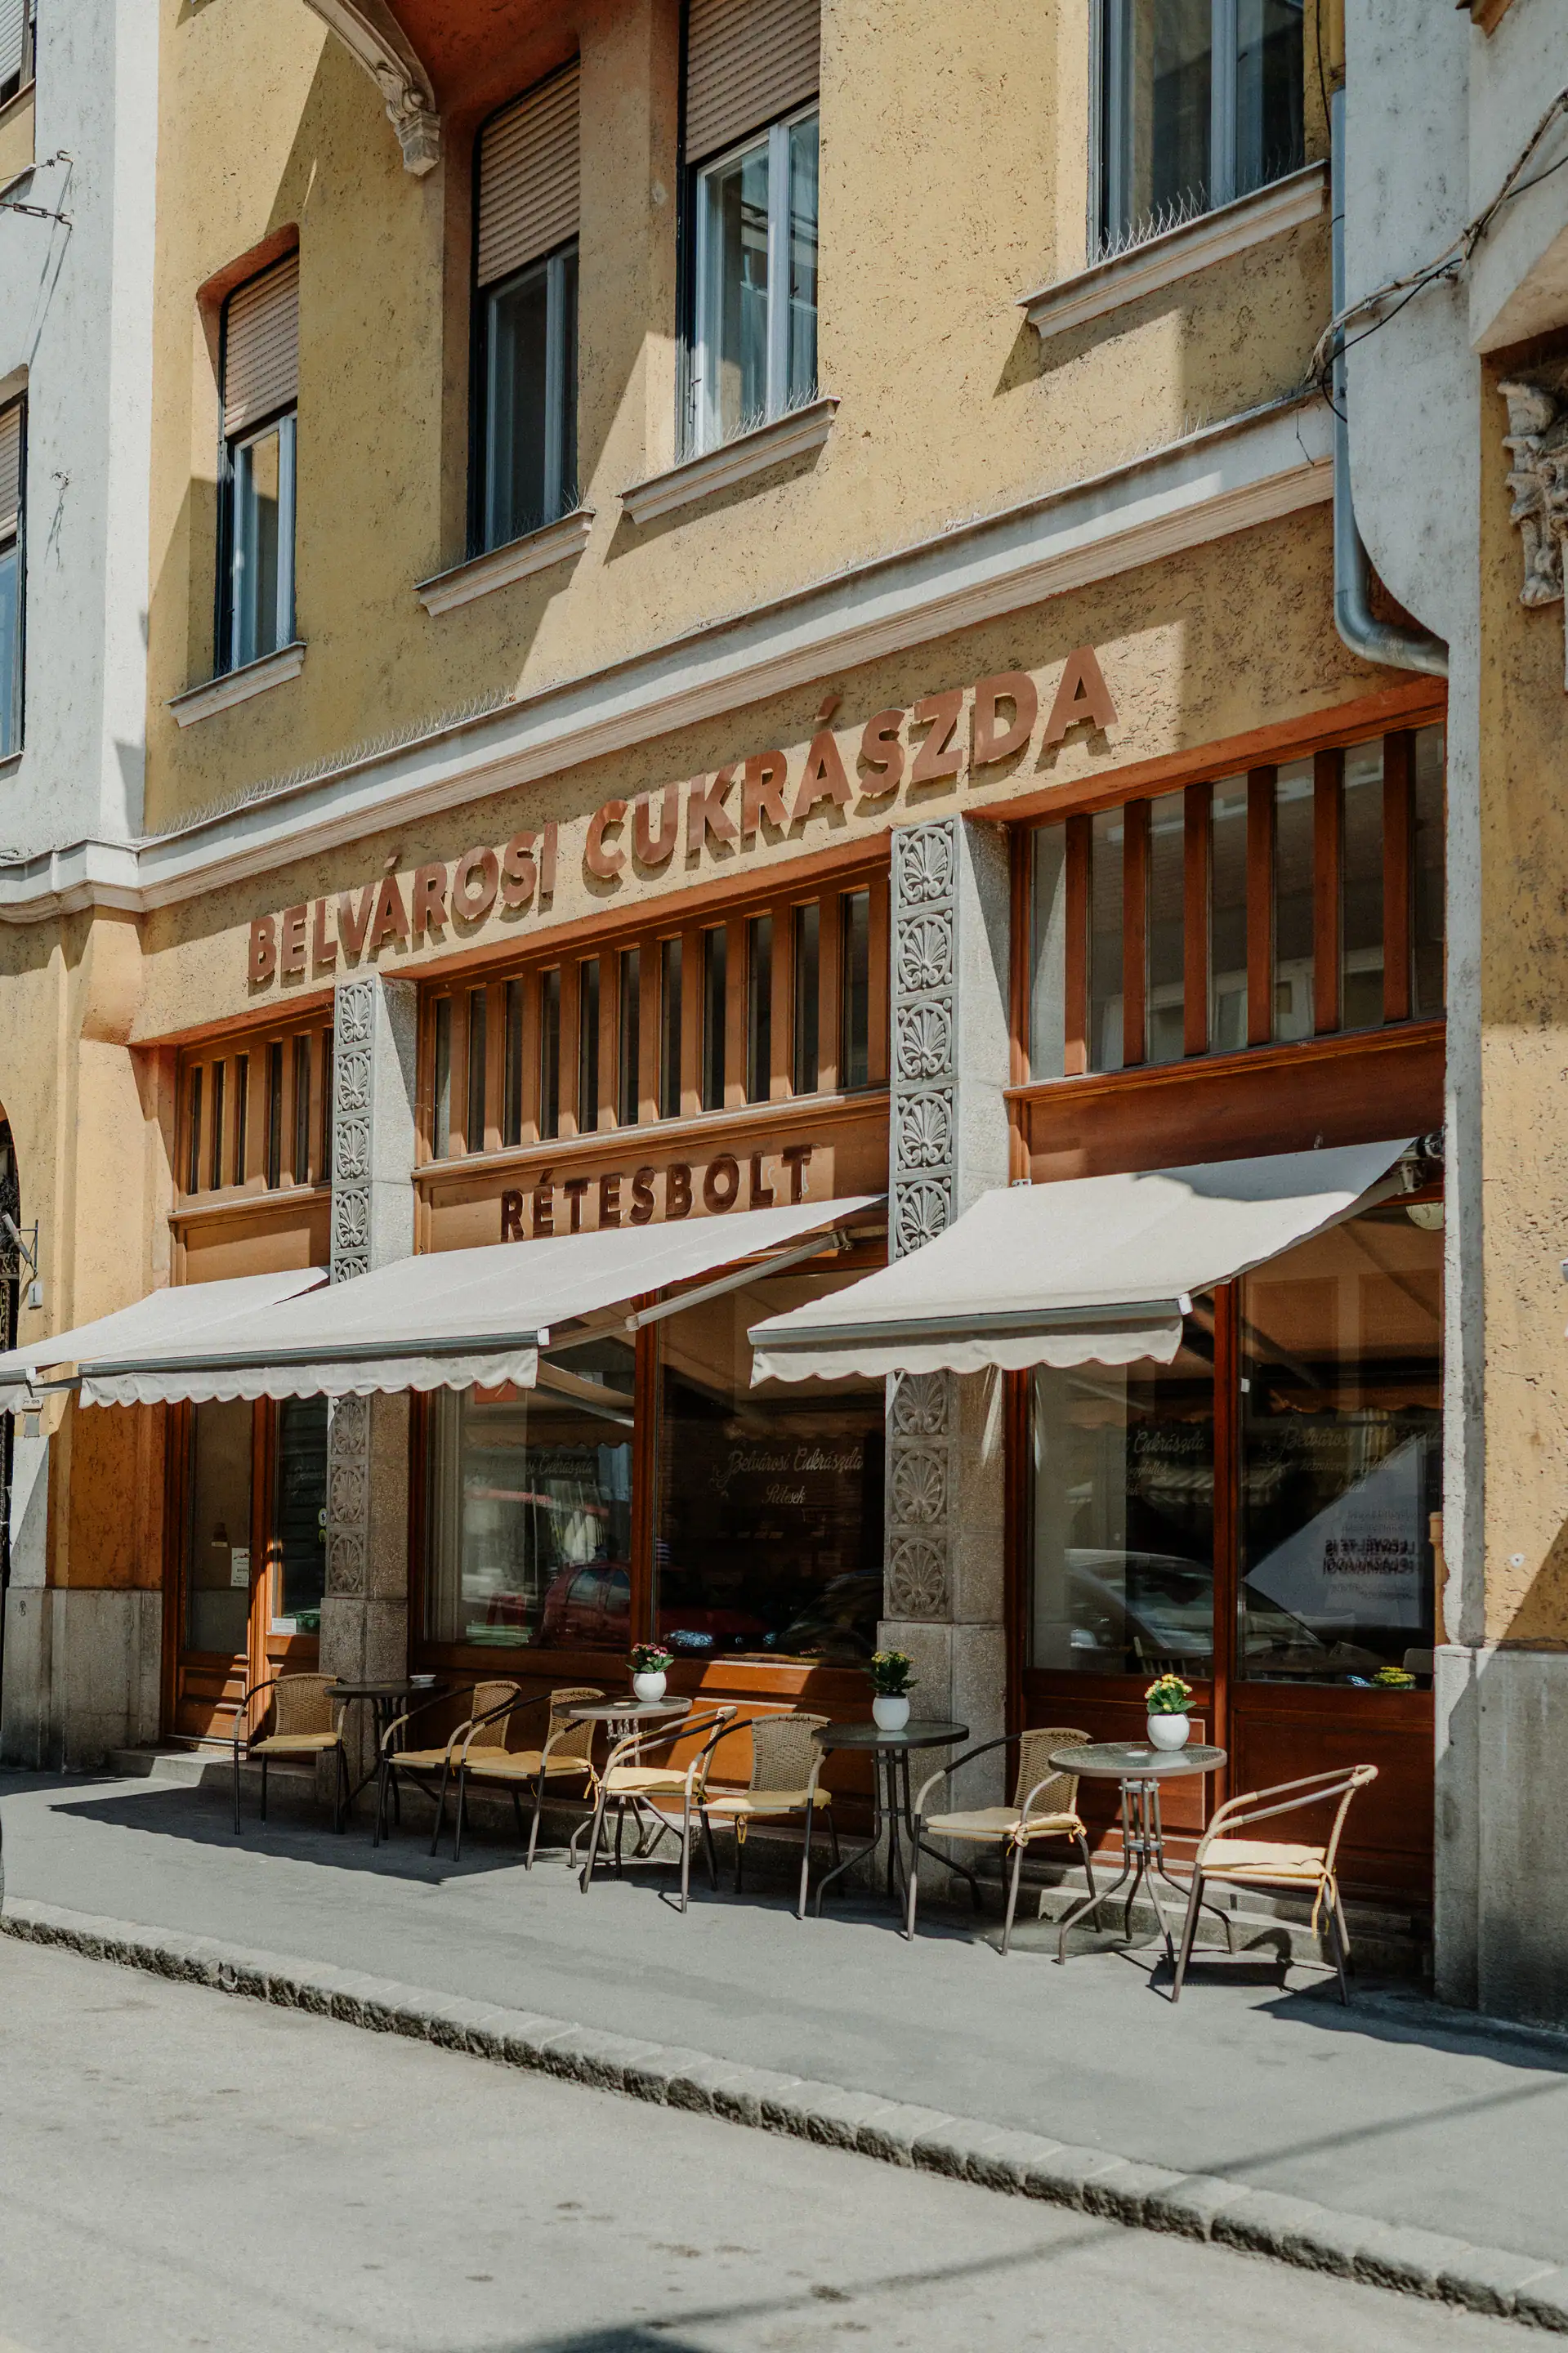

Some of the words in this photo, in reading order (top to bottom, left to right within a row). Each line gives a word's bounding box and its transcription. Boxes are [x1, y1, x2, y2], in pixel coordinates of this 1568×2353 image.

[248, 820, 558, 981] BELVÁROSI
[584, 644, 1118, 878] CUKRÁSZDA
[500, 1143, 813, 1243] RÉTESBOLT
[32, 1287, 37, 1302] 1
[1133, 1429, 1206, 1454] Cukrászda
[724, 1449, 790, 1476] Belvárosi
[793, 1444, 863, 1474] Cukrászda
[762, 1483, 806, 1504] Rétesek
